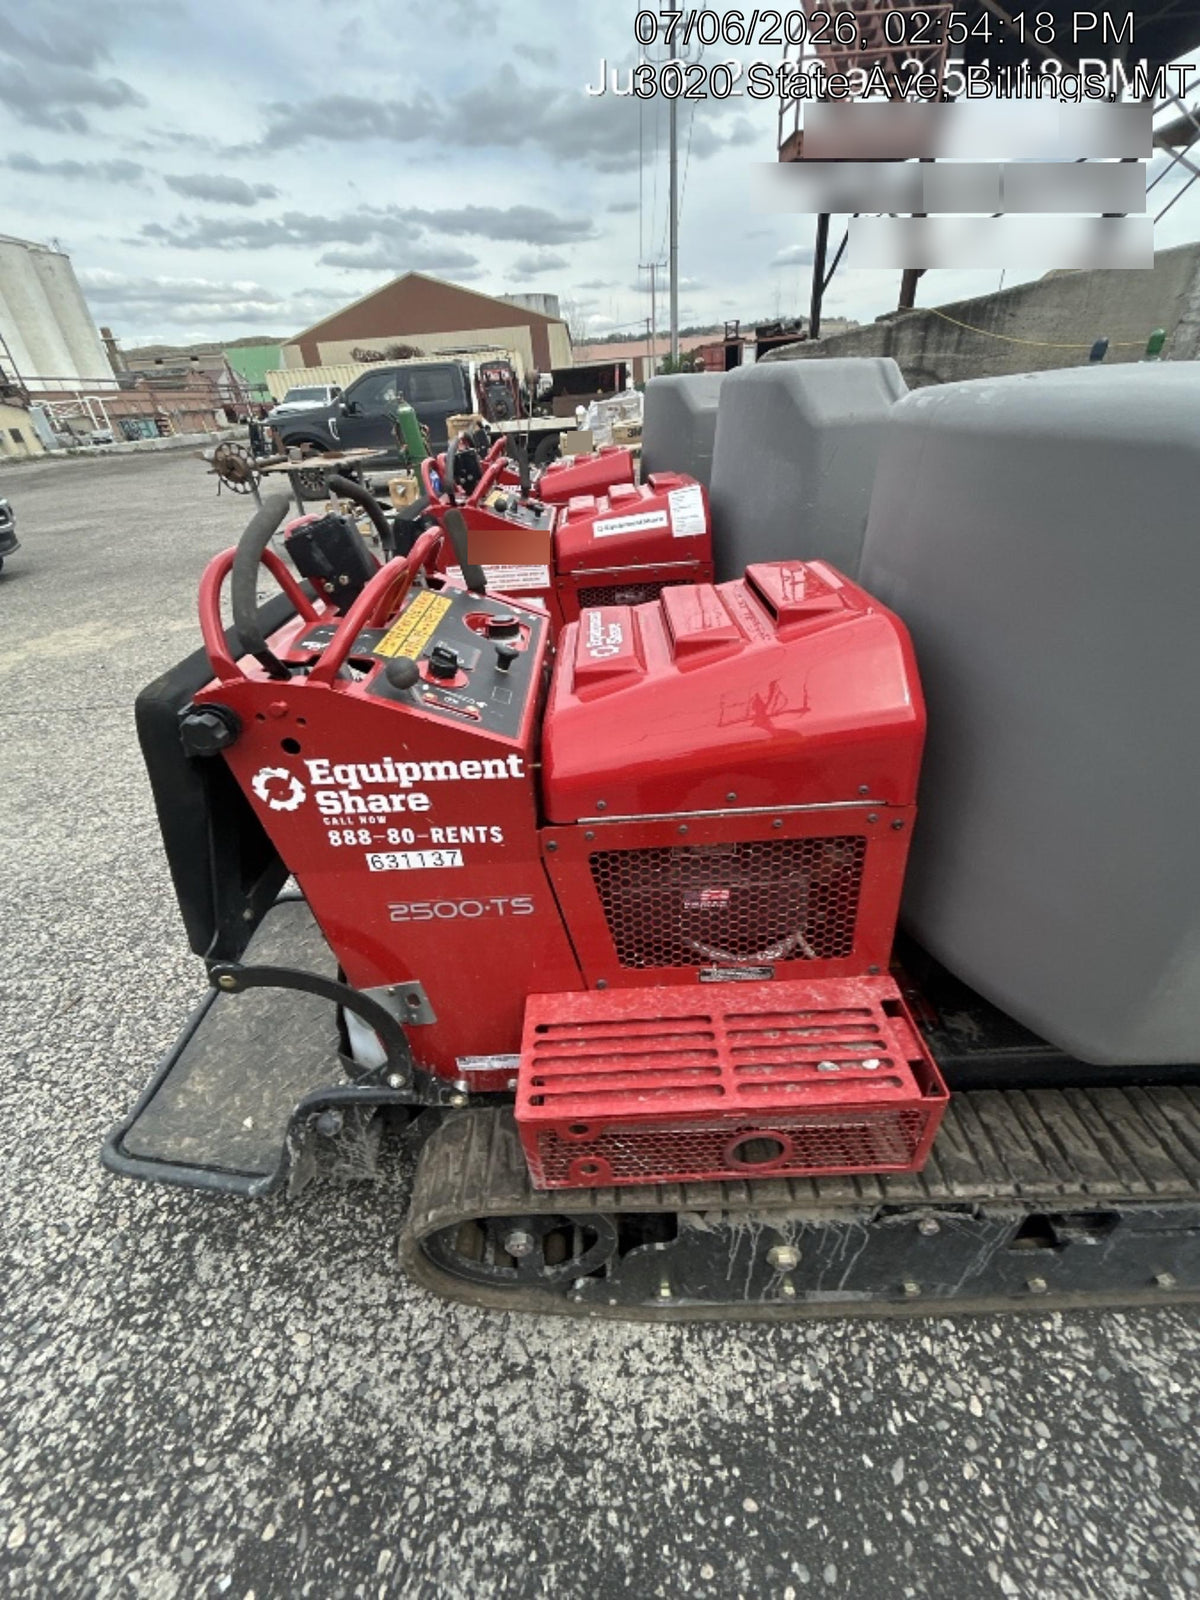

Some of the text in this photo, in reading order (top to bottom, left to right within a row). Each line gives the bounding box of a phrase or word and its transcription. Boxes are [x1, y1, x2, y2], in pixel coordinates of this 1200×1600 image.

[304, 754, 525, 789] Equipment
[315, 789, 431, 815] Share
[323, 815, 387, 826] CALL NOW
[328, 826, 504, 847] 888-80-RENTS
[370, 851, 458, 870] 631137
